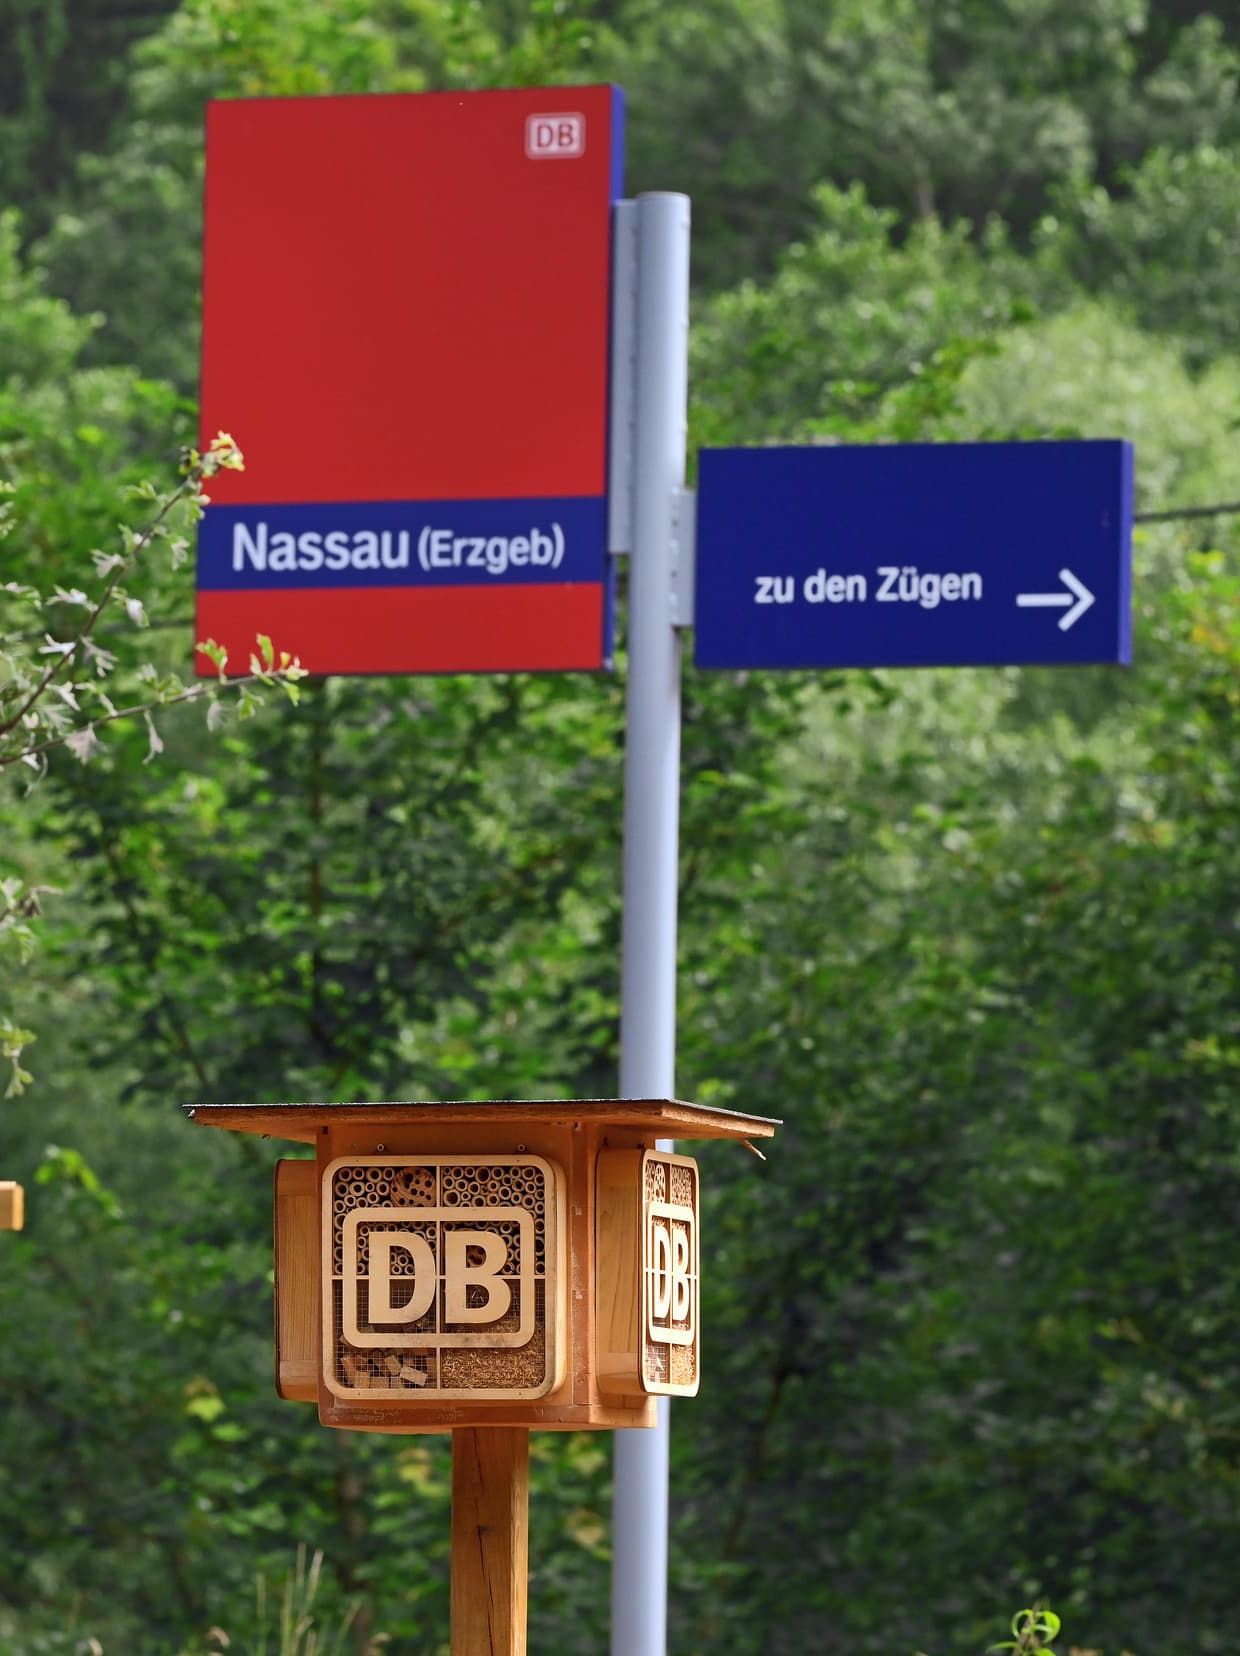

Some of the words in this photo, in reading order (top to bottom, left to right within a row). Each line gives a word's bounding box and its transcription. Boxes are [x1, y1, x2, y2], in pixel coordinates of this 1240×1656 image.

[537, 124, 573, 147] DB
[232, 522, 409, 571] Nassau
[418, 522, 565, 574] (Erzgeb)
[754, 575, 794, 603] zu
[804, 568, 866, 603] den
[875, 566, 982, 608] Zügen
[368, 1231, 511, 1324] DB
[652, 1225, 690, 1321] DB
